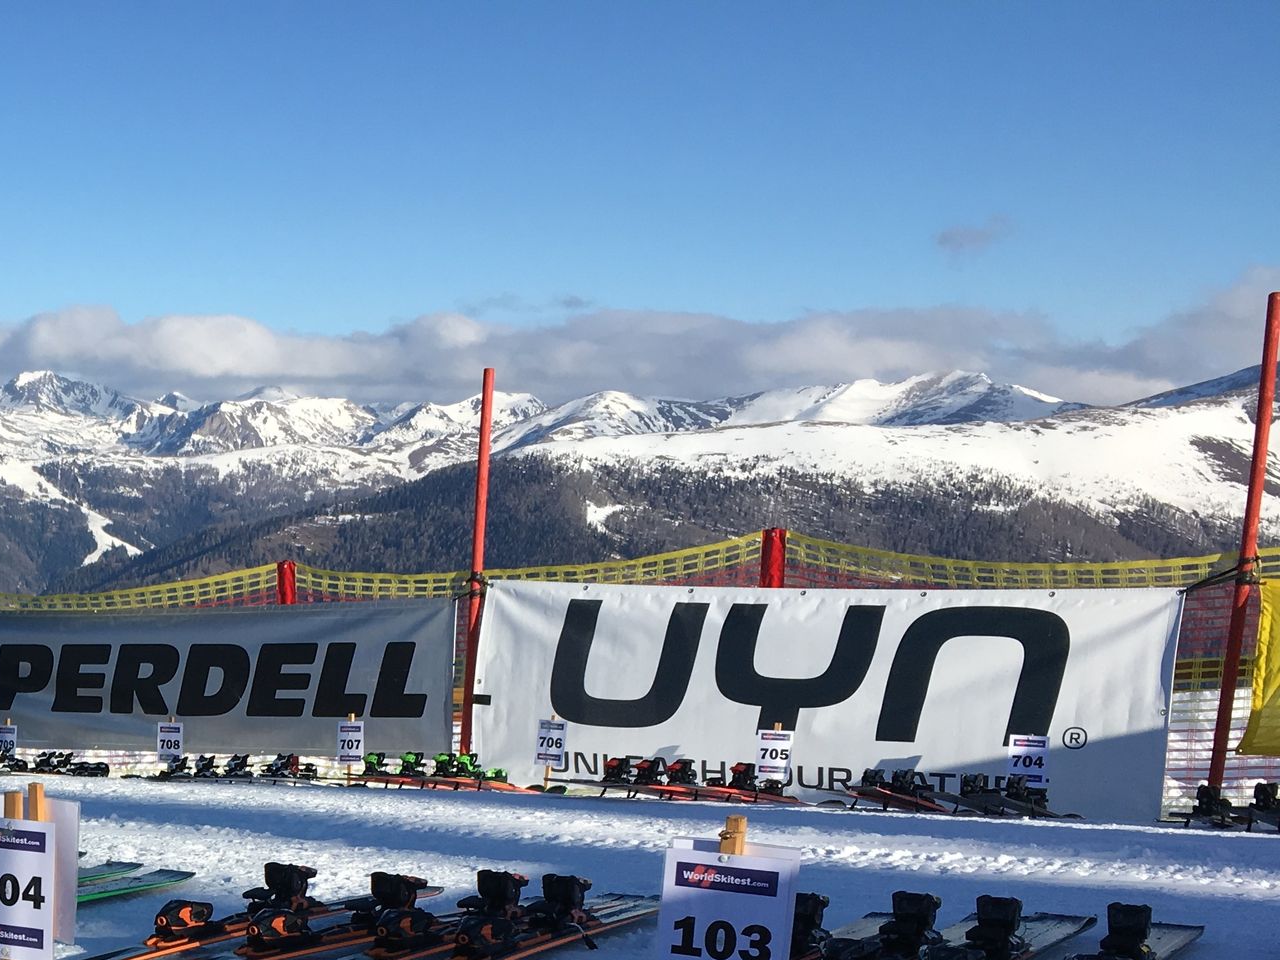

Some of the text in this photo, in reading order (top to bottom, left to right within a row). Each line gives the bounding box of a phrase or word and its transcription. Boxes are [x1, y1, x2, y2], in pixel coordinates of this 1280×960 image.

[0, 739, 14, 750] 709
[159, 739, 180, 750] 708
[340, 739, 361, 750] 707
[538, 736, 563, 749] 706
[760, 748, 789, 760] 705
[1012, 755, 1044, 768] 704
[683, 870, 769, 888] WorldSkitest.com
